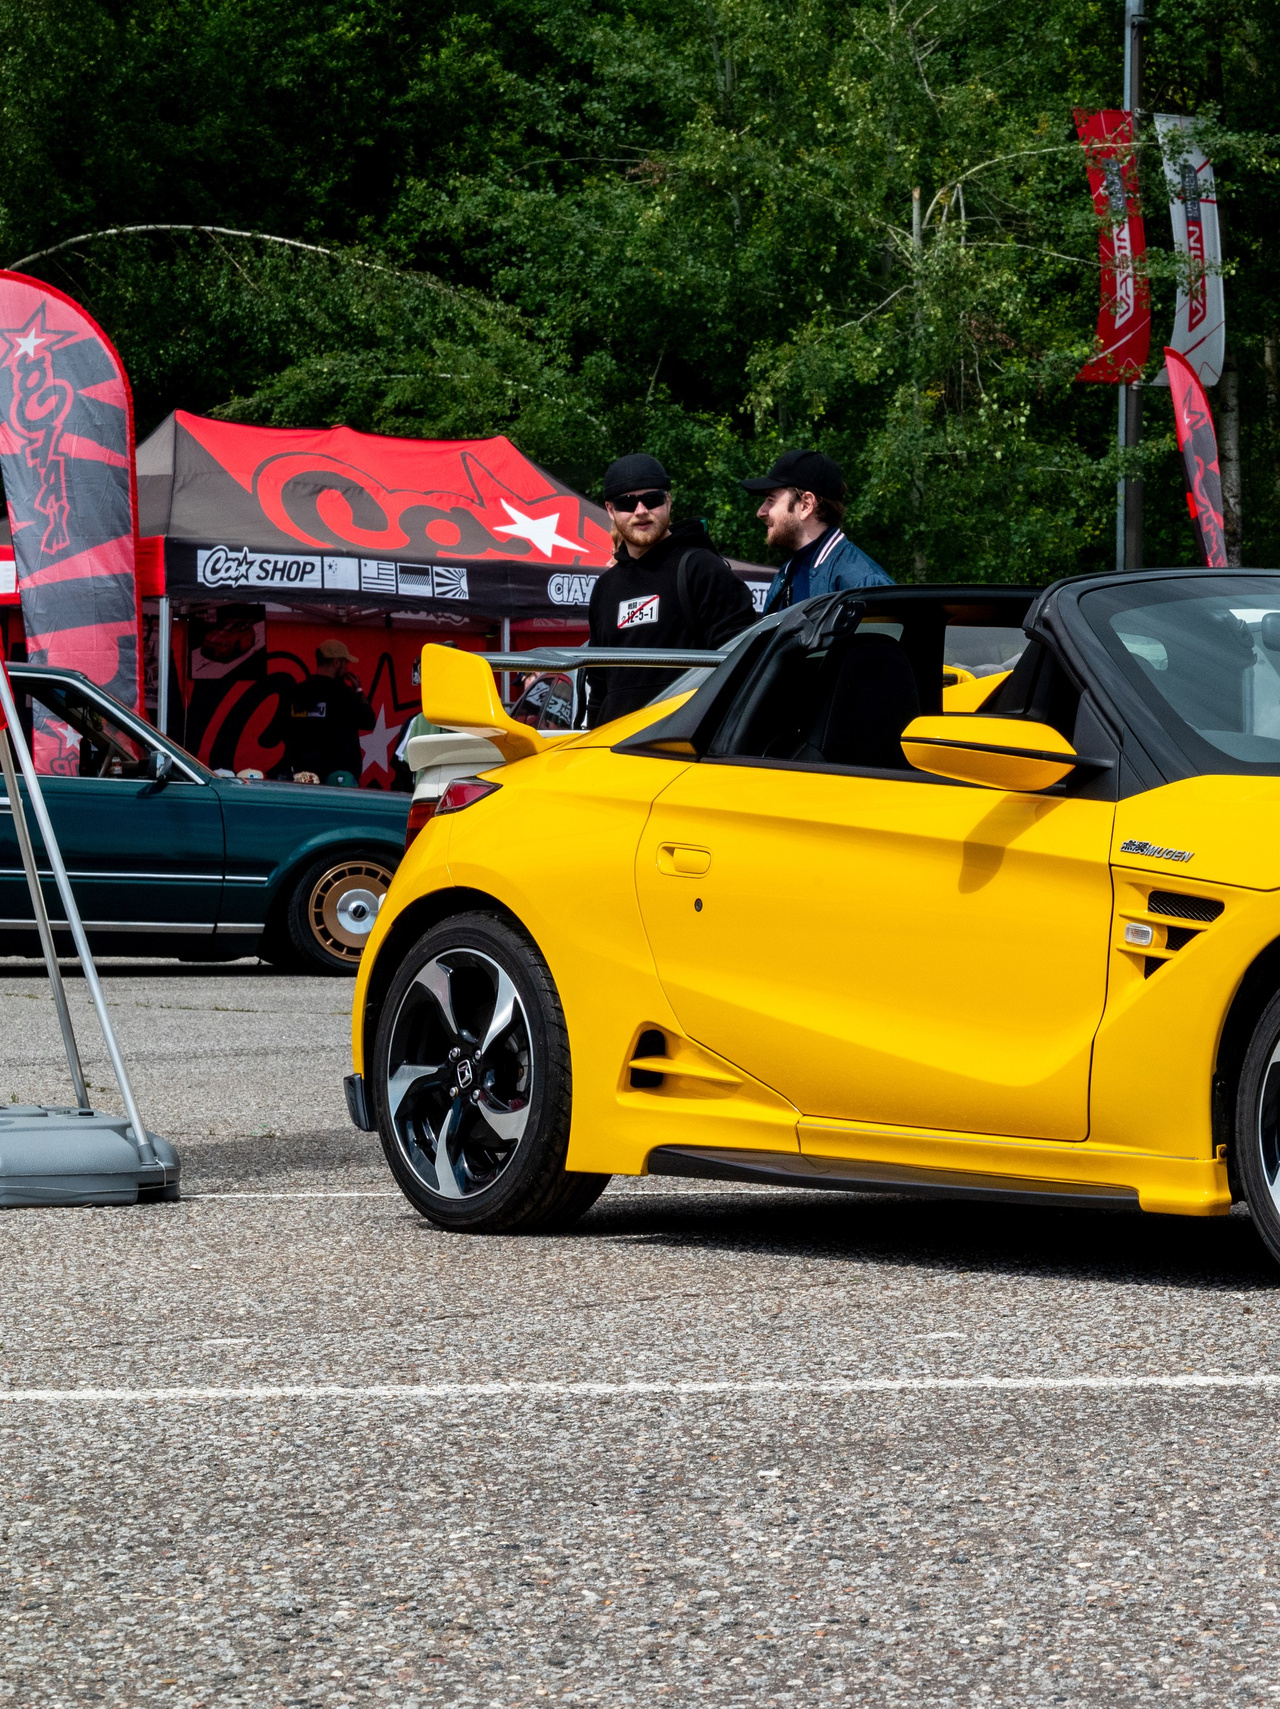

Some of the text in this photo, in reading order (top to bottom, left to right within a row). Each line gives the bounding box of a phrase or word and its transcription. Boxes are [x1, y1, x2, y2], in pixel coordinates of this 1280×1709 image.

[1187, 225, 1205, 325] VAIN
[255, 560, 316, 582] SHOP
[1144, 844, 1195, 863] MUGEN
